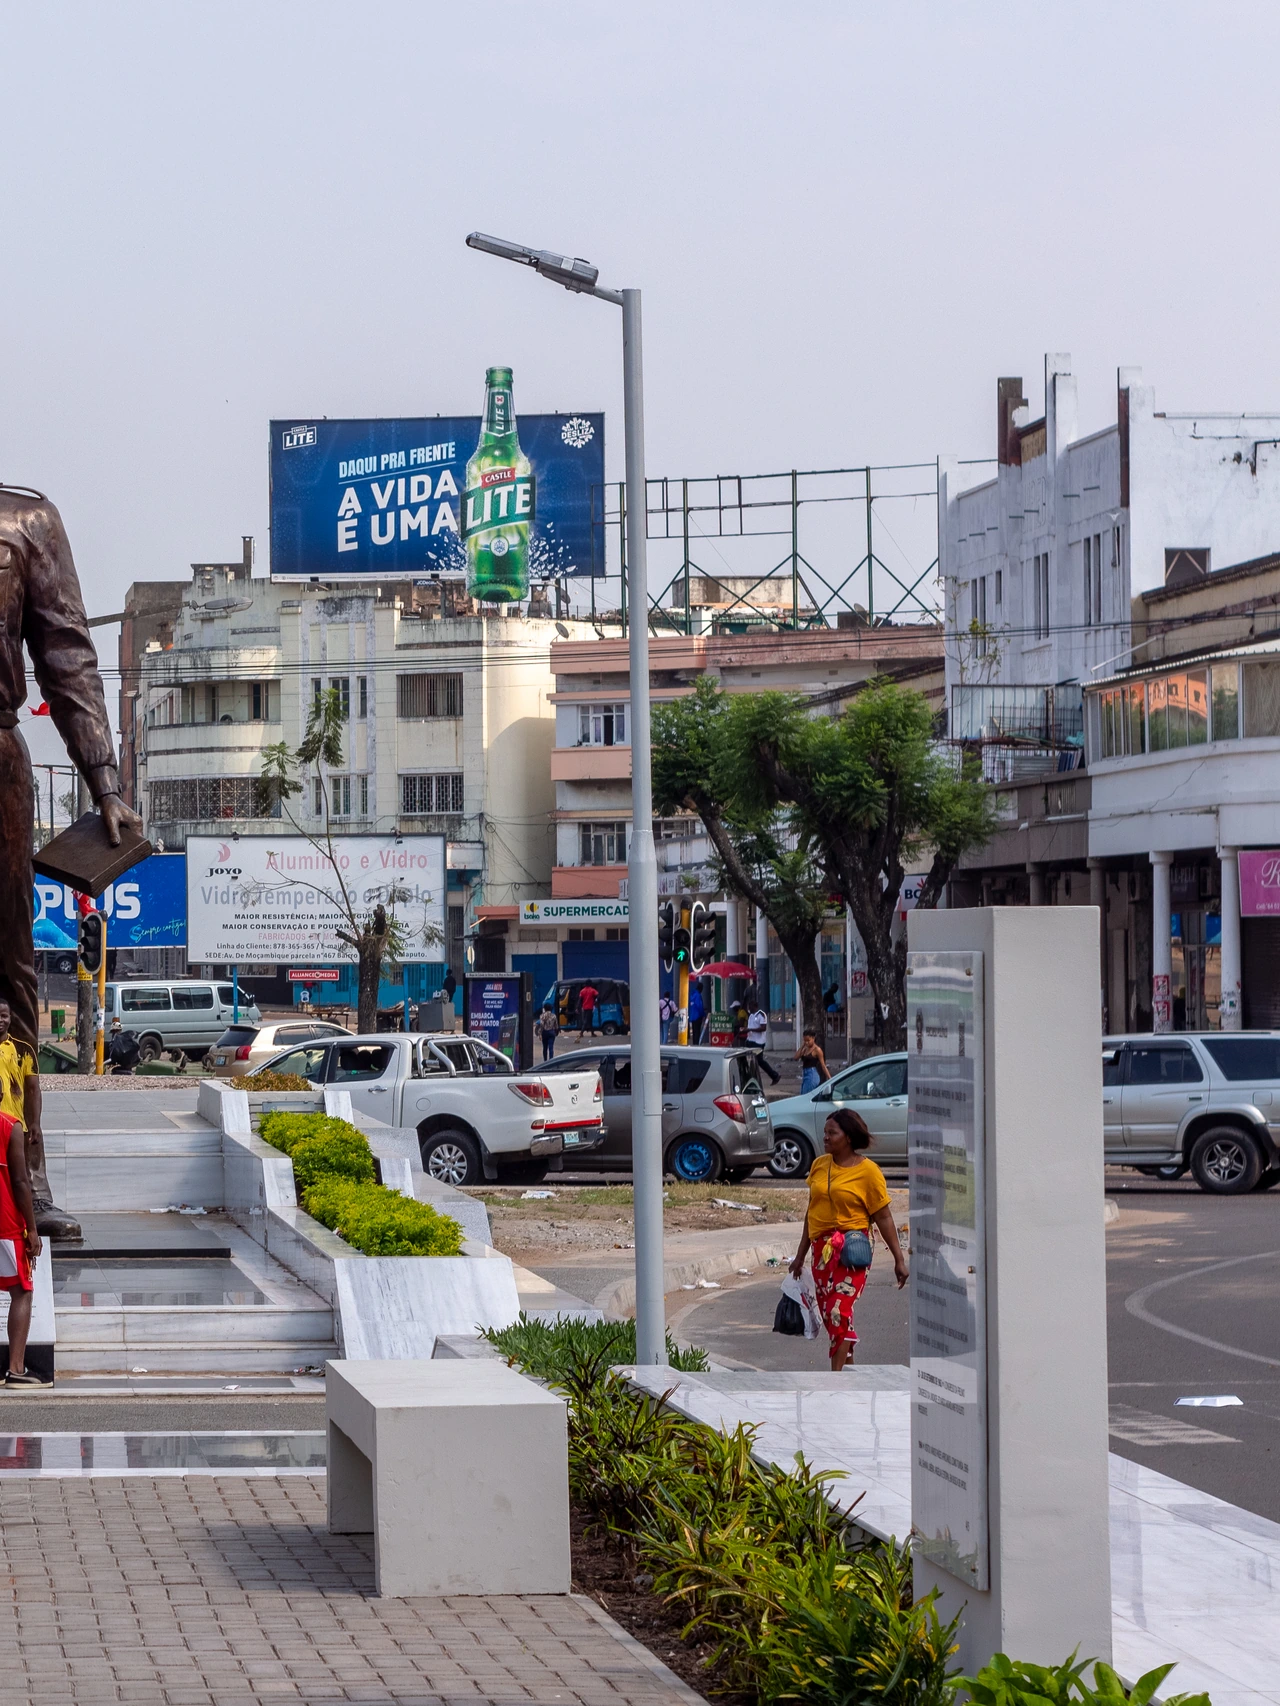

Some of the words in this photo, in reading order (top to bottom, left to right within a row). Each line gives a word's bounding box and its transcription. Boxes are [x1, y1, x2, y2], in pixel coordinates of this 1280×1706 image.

[495, 407, 504, 430] LITE
[285, 431, 314, 447] LITE
[561, 427, 595, 440] DESLIZA
[339, 457, 377, 479] DAQUI
[380, 450, 406, 471] PRA
[410, 442, 456, 464] FRENTE
[485, 470, 512, 483] CASTLE
[337, 487, 362, 517] A
[371, 469, 458, 510] VIDA
[466, 483, 531, 531] LITE
[337, 511, 359, 552] É
[371, 502, 458, 546] UMA
[265, 849, 350, 870] Alumínio
[360, 855, 369, 870] e
[379, 849, 428, 869] Vidro
[205, 867, 242, 878] JOYO
[201, 886, 250, 905] Vidro
[262, 912, 317, 920] RESISTÊNCIA;
[544, 904, 629, 917] SUPERMERCAD
[250, 922, 308, 931] CONSERVAÇÃO
[258, 932, 306, 941] FABRICADOS
[245, 952, 289, 960] Moçambique
[290, 952, 315, 960] parcela
